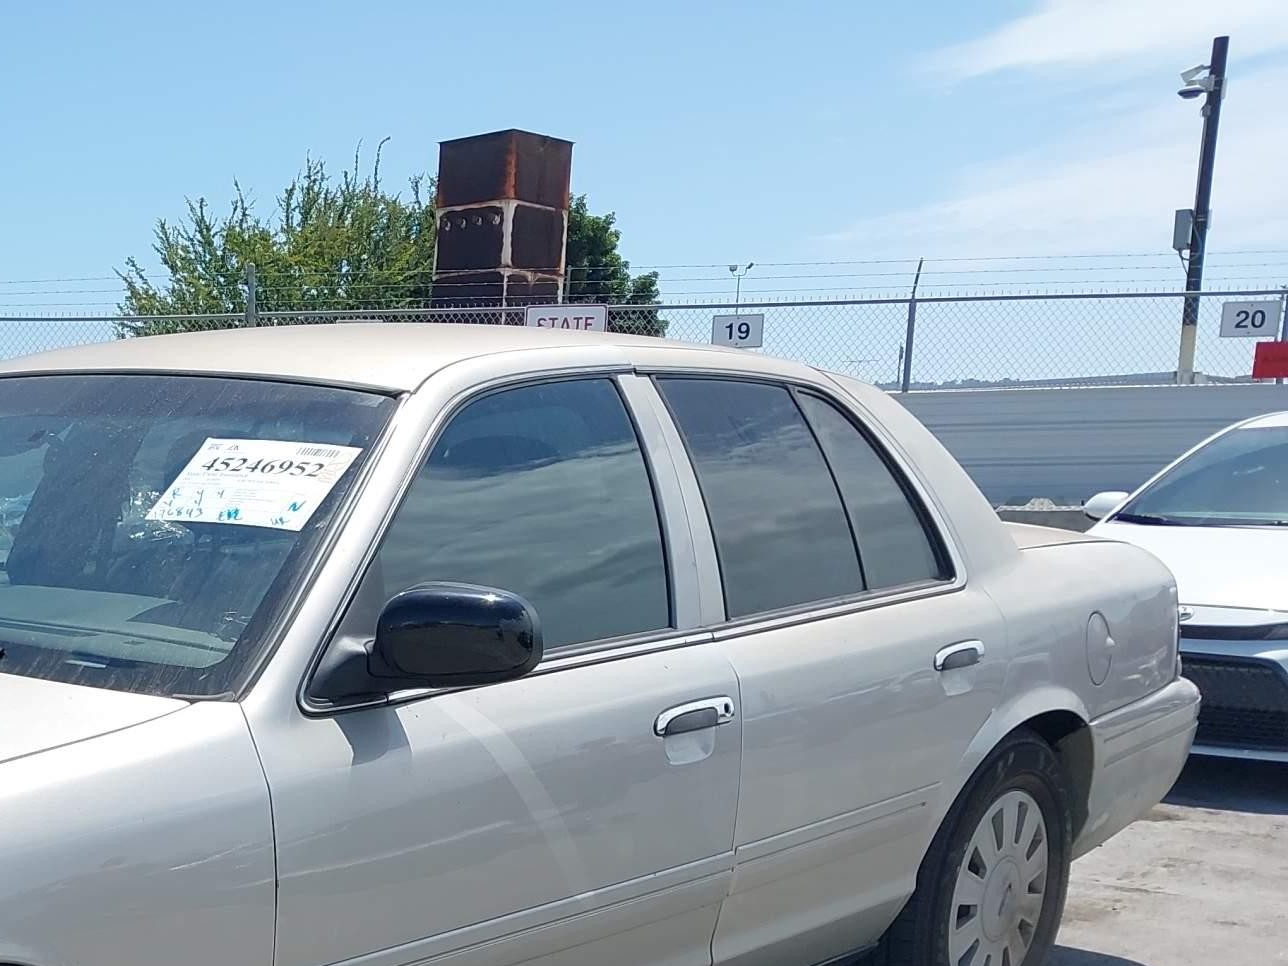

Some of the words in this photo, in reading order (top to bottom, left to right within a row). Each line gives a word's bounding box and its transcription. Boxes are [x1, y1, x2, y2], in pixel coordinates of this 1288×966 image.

[1234, 309, 1266, 329] 20
[725, 322, 750, 340] 19
[201, 457, 326, 478] 45246952
